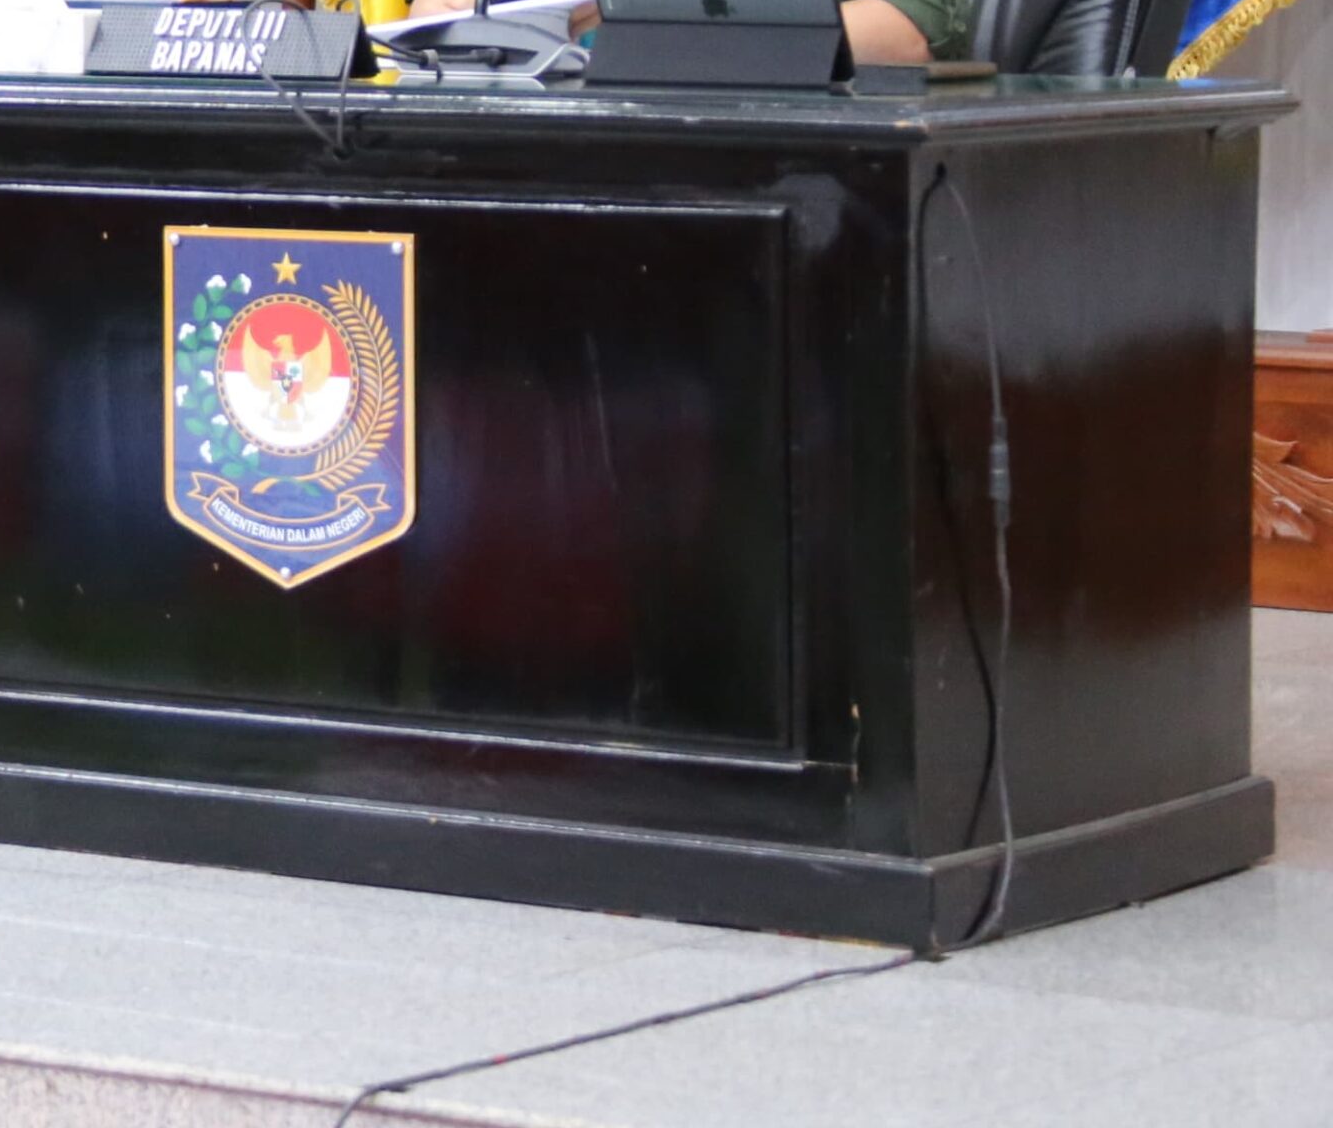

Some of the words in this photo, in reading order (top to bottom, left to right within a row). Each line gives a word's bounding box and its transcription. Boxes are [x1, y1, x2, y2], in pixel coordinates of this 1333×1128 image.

[251, 9, 286, 40] III
[150, 40, 266, 73] BAPANAS
[211, 497, 285, 541] KEMENTERIAN
[286, 528, 326, 543] DALAM
[326, 507, 367, 538] NEGERI
